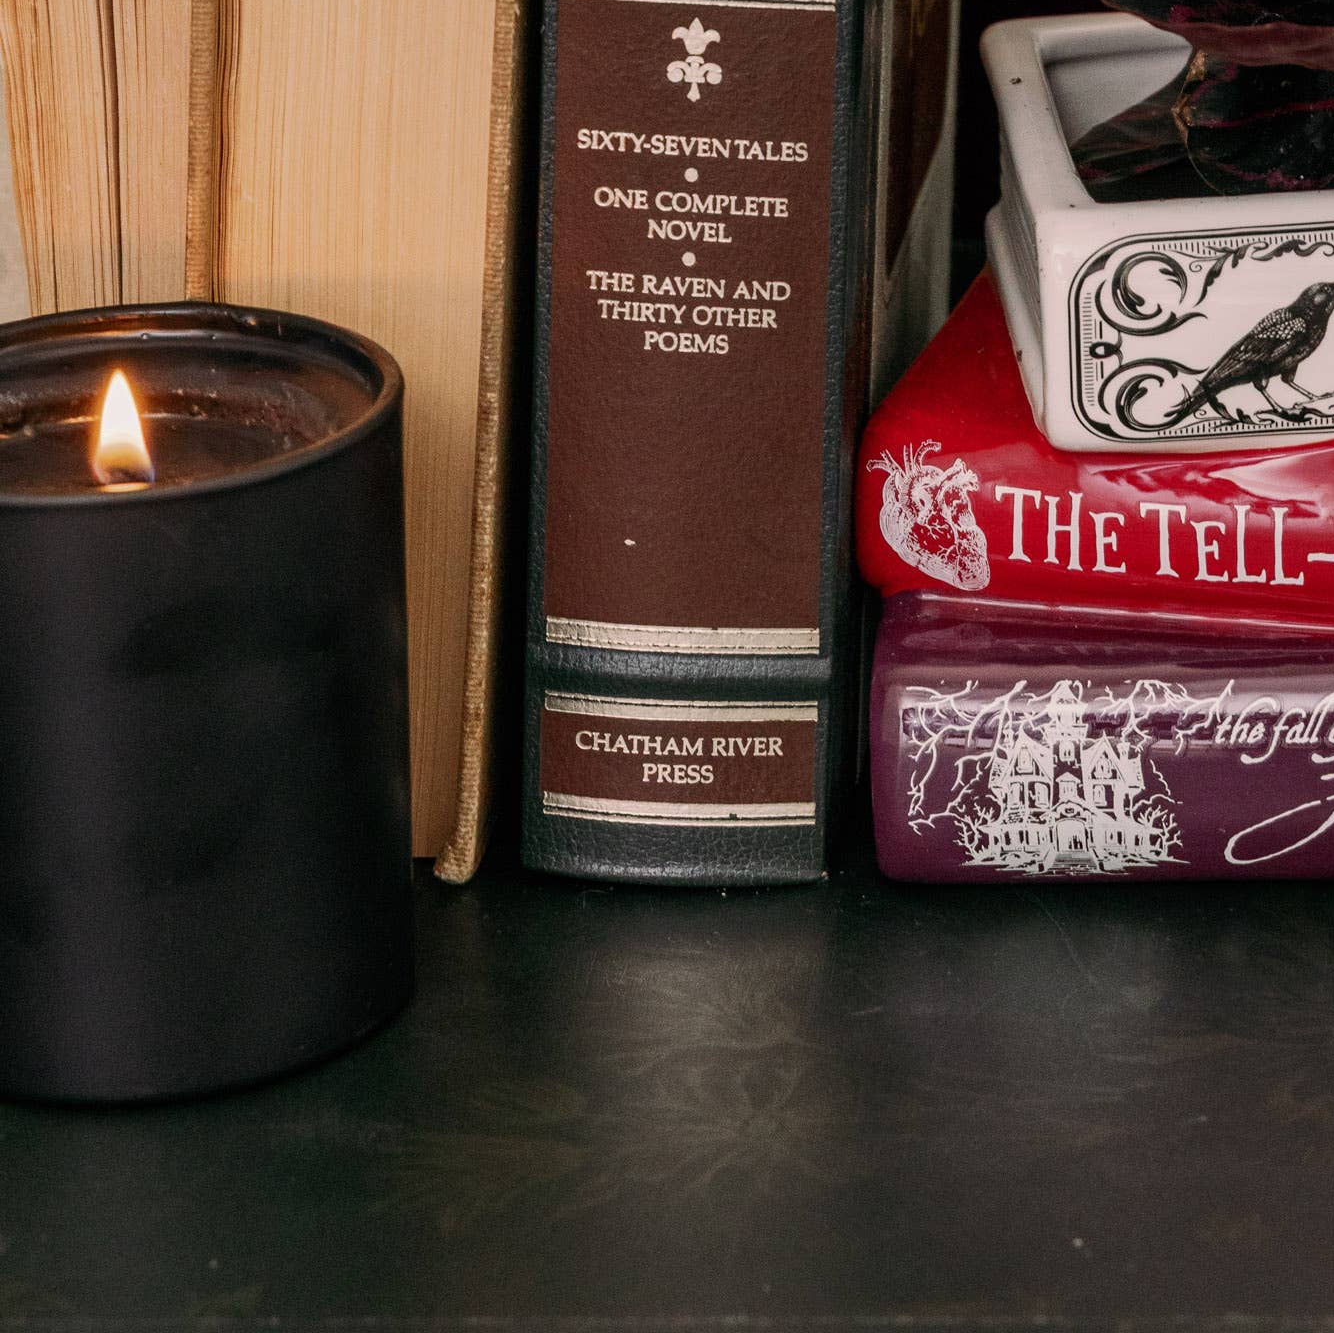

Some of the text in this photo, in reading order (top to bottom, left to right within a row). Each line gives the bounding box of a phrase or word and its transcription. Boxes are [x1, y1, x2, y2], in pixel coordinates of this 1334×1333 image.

[577, 129, 808, 162] SIXTY-SEVEN TALES
[594, 187, 789, 218] ONE COMPLETE
[647, 219, 732, 244] NOVEL
[586, 270, 791, 302] THE RAVEN AND
[597, 299, 777, 329] THIRTY OTHER
[644, 331, 729, 355] POEMS
[994, 486, 1127, 573] THE
[1215, 696, 1277, 745] the
[575, 730, 783, 757] CHATHAM RIVER
[642, 763, 714, 784] PRESS
